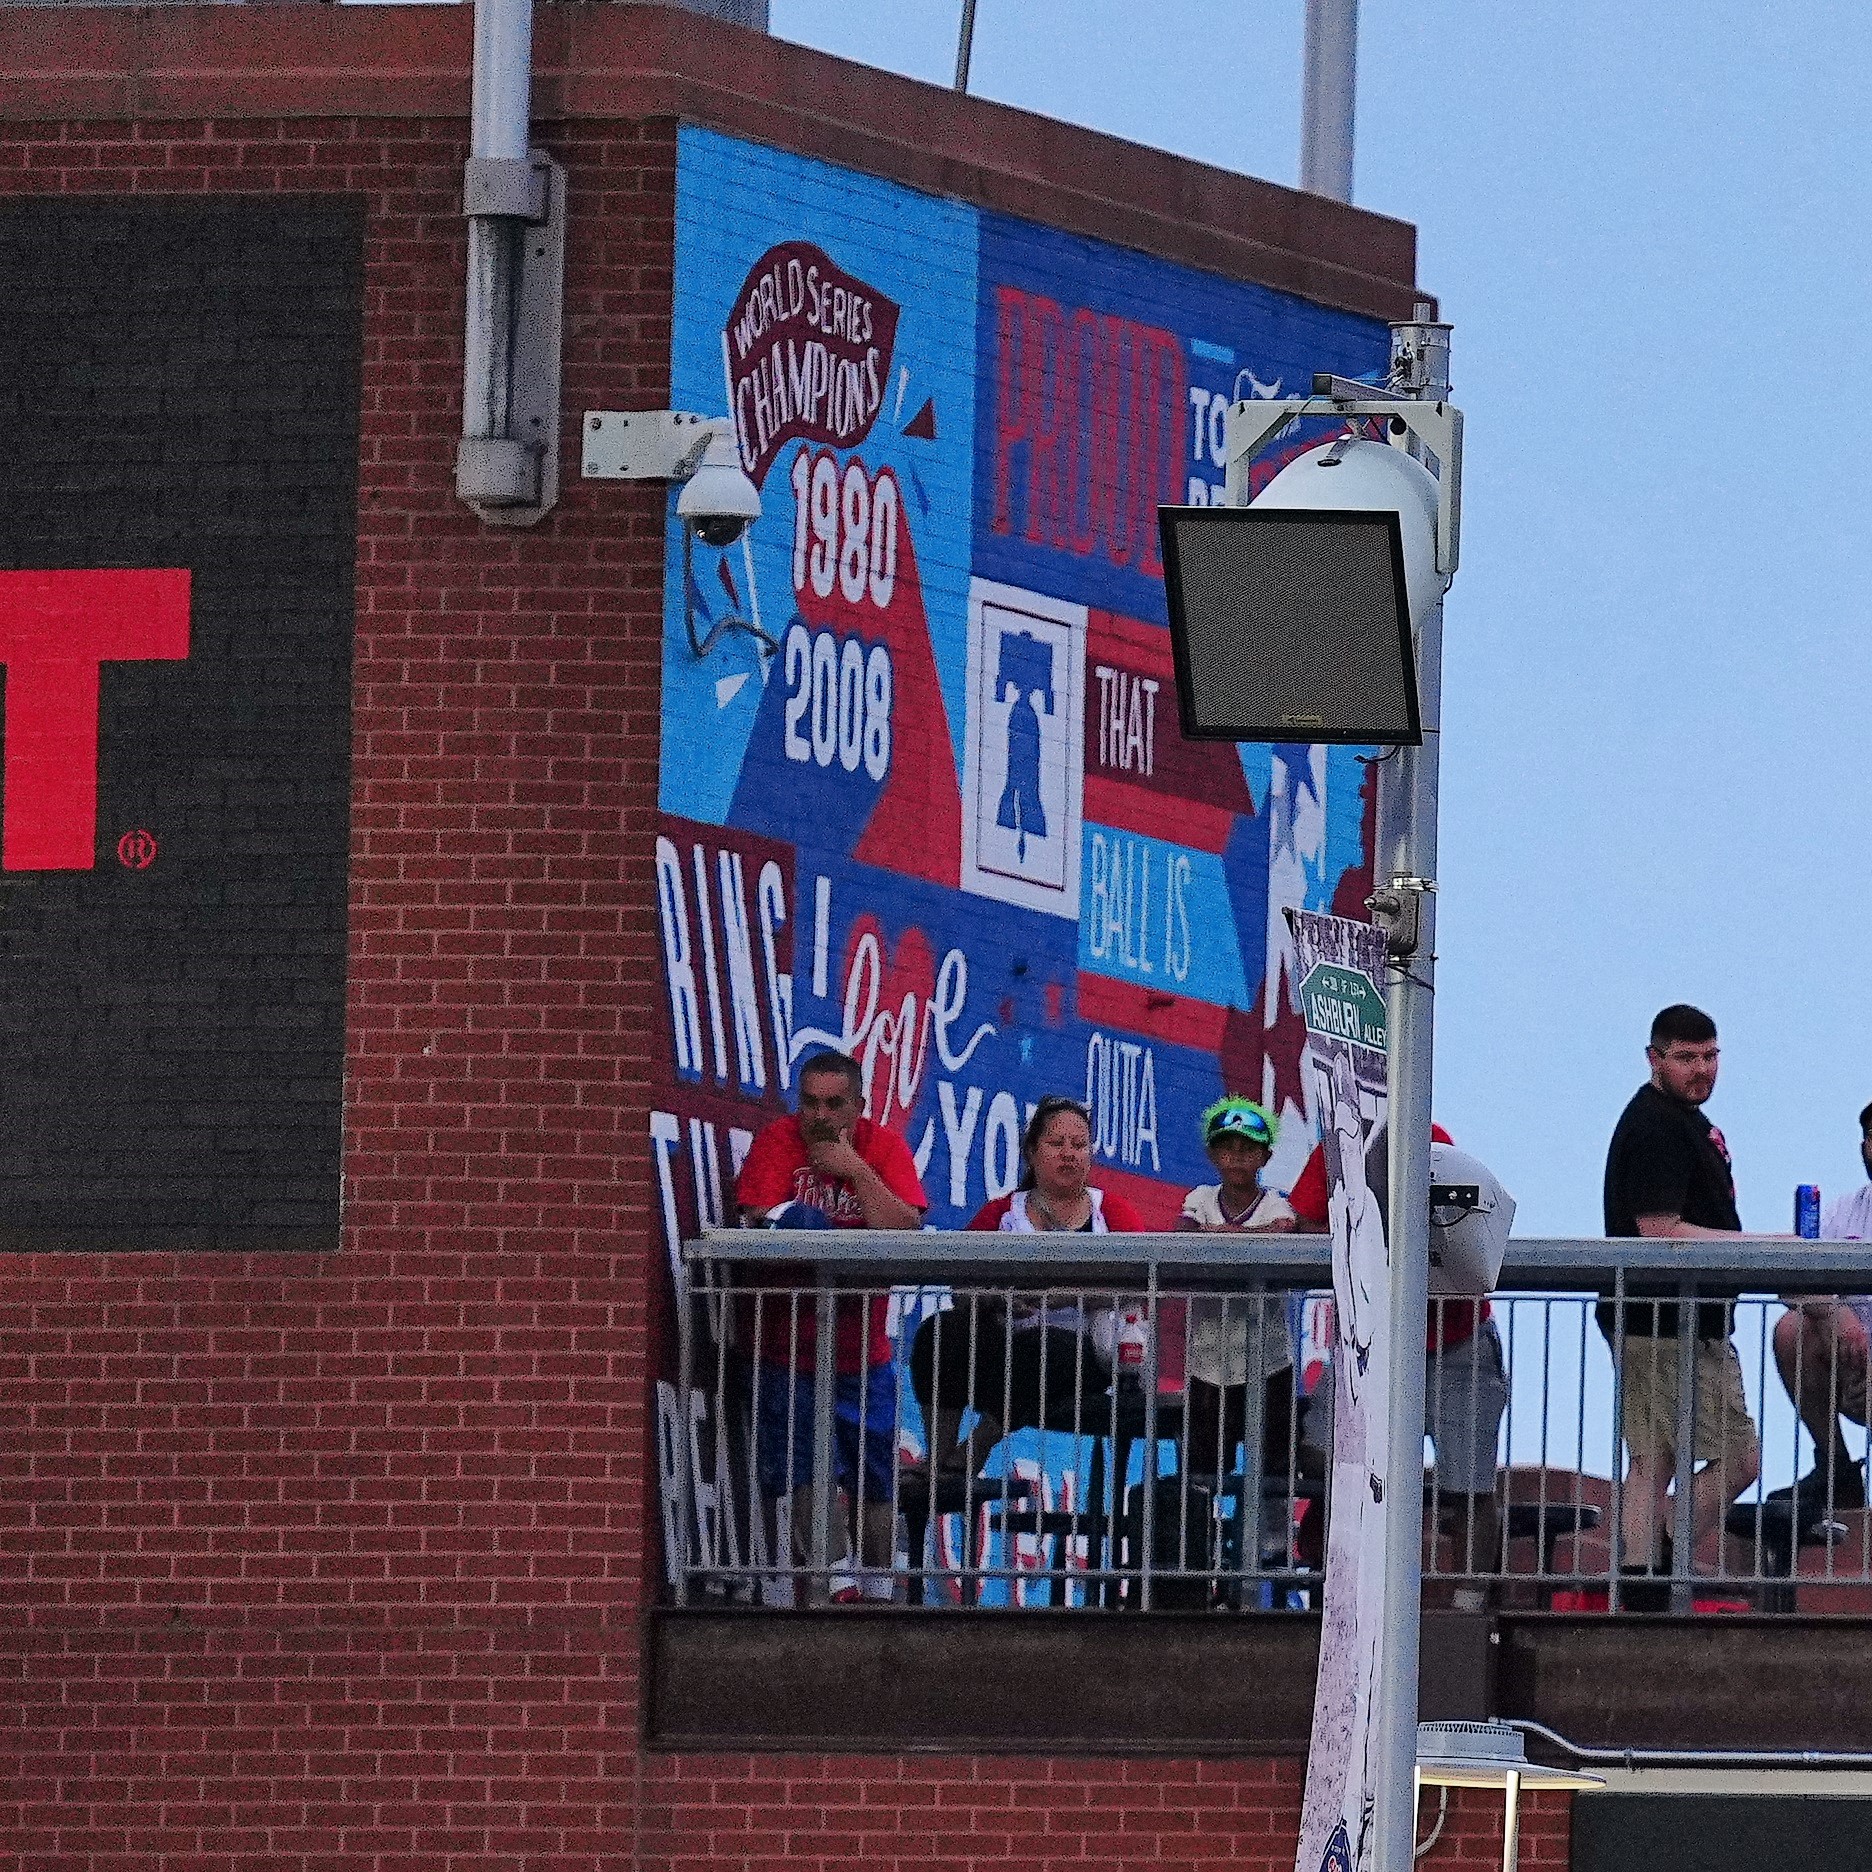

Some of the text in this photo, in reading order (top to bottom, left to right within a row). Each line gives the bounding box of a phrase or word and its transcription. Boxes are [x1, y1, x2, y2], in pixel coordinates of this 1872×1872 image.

[734, 258, 873, 360] WORLD SERIES
[737, 339, 881, 473] CHAMPIONS
[992, 285, 1188, 581] PROUD
[791, 451, 900, 609] 1980
[785, 624, 893, 782] 2008
[1095, 665, 1160, 777] THAT
[655, 835, 794, 1093] RING
[1090, 833, 1192, 982] BALL IS
[938, 1080, 1036, 1208] YO
